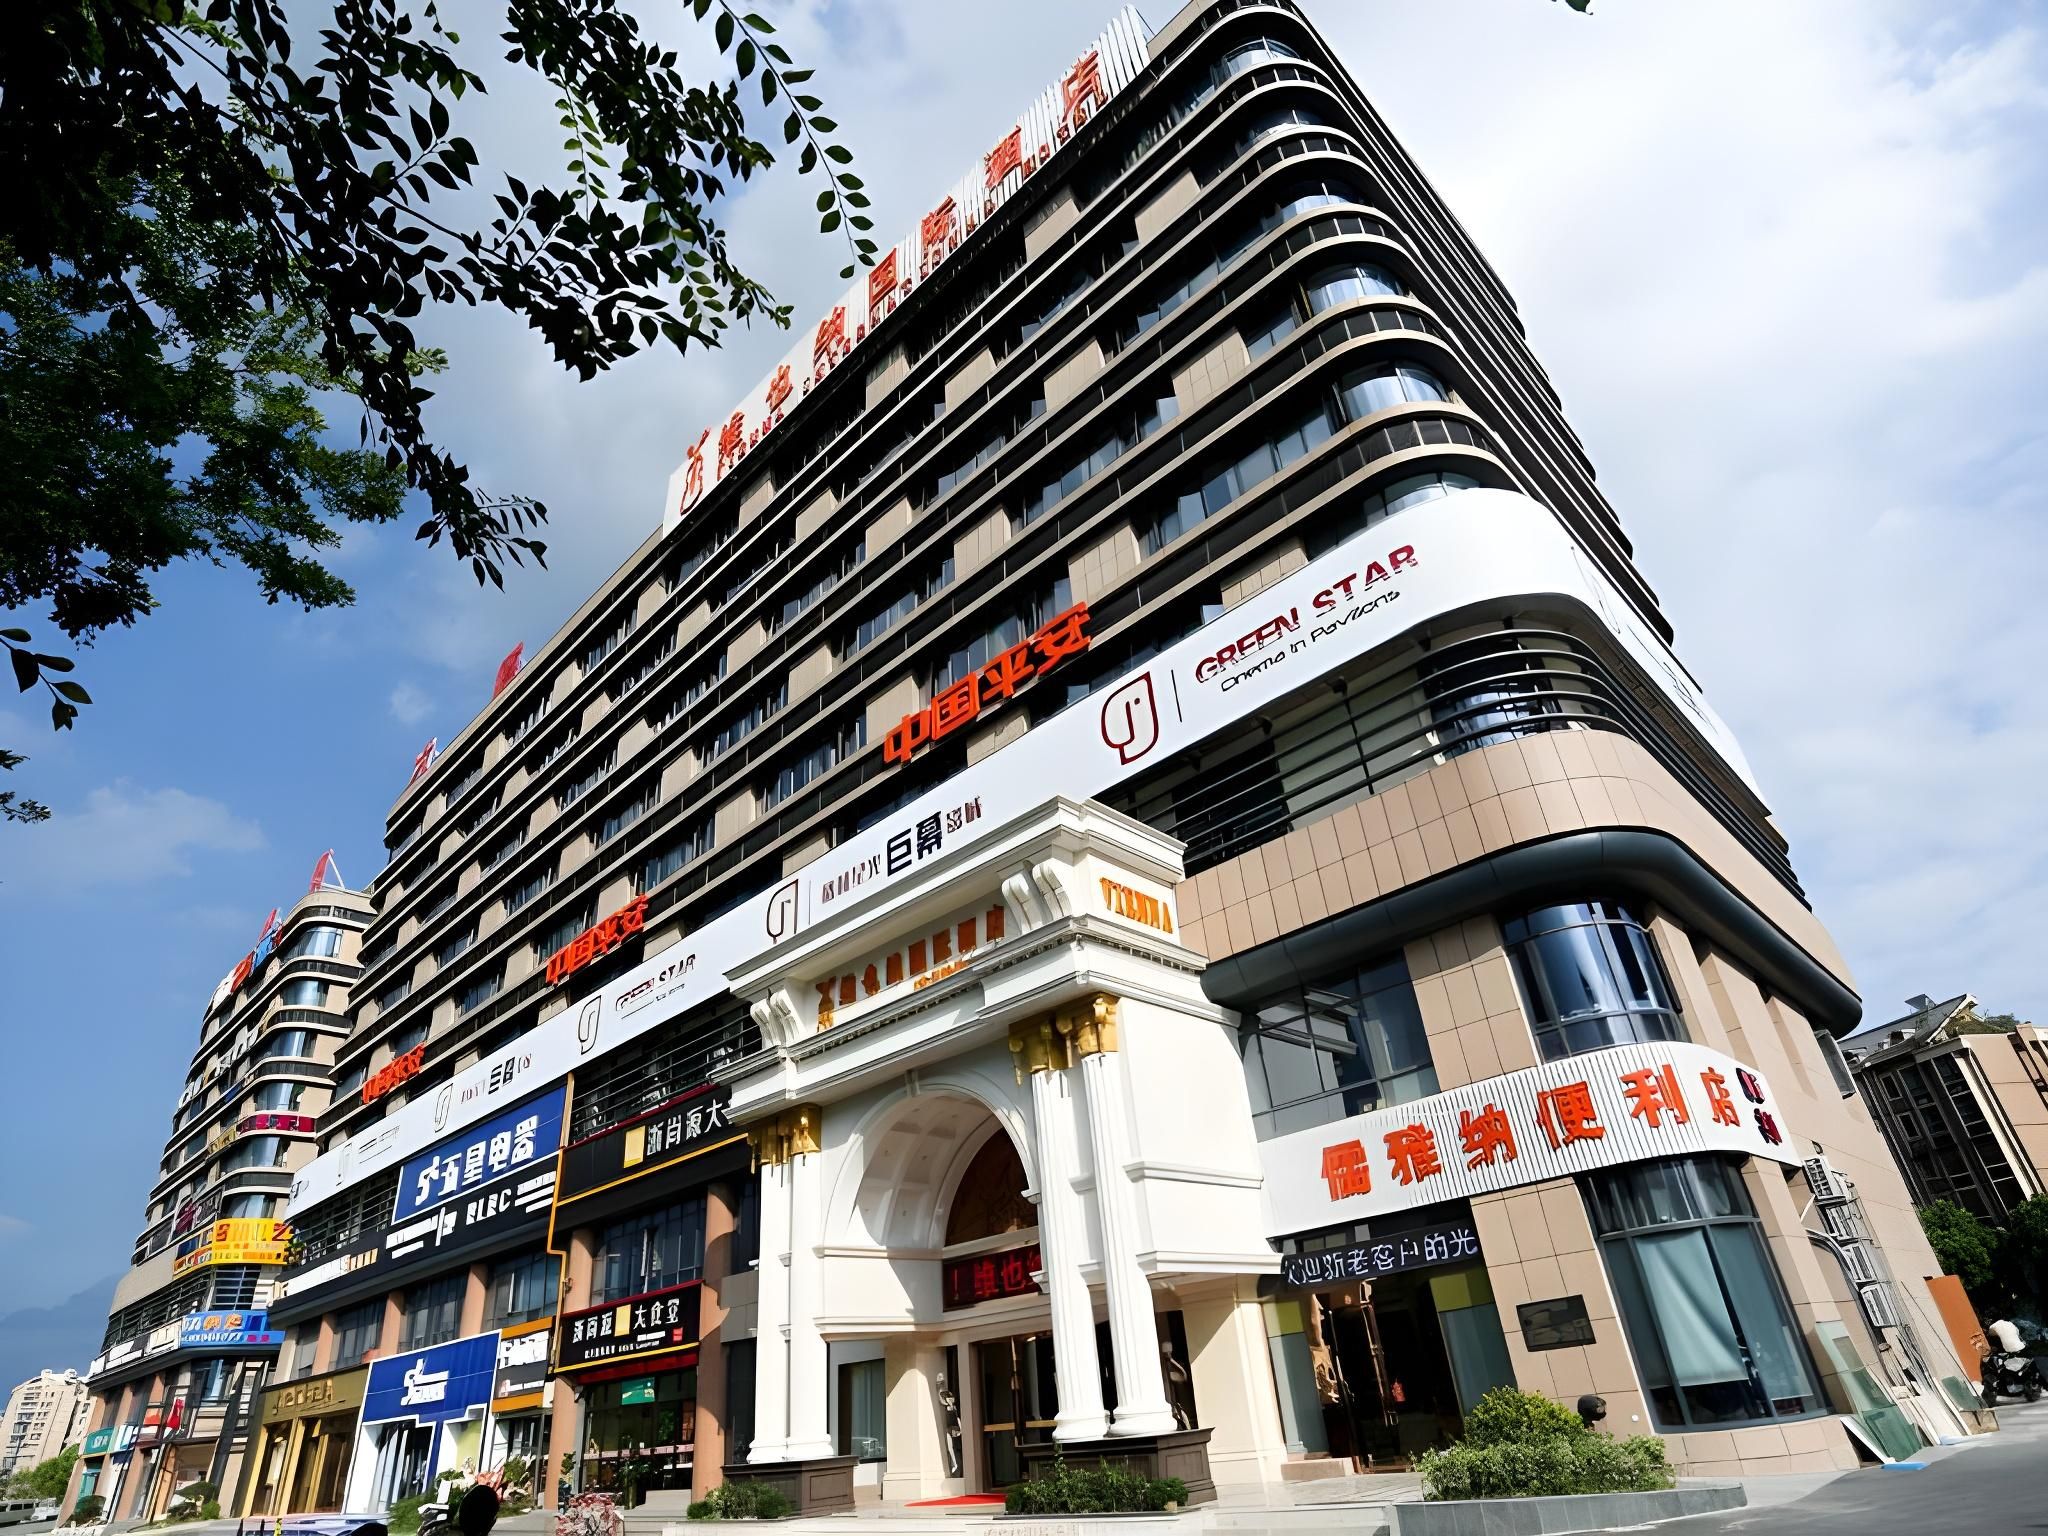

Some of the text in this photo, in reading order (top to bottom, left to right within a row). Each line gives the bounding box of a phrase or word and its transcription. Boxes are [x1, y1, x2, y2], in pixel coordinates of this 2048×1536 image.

[883, 601, 1092, 764] 中国平安
[1195, 544, 1419, 684] GREEN STAR
